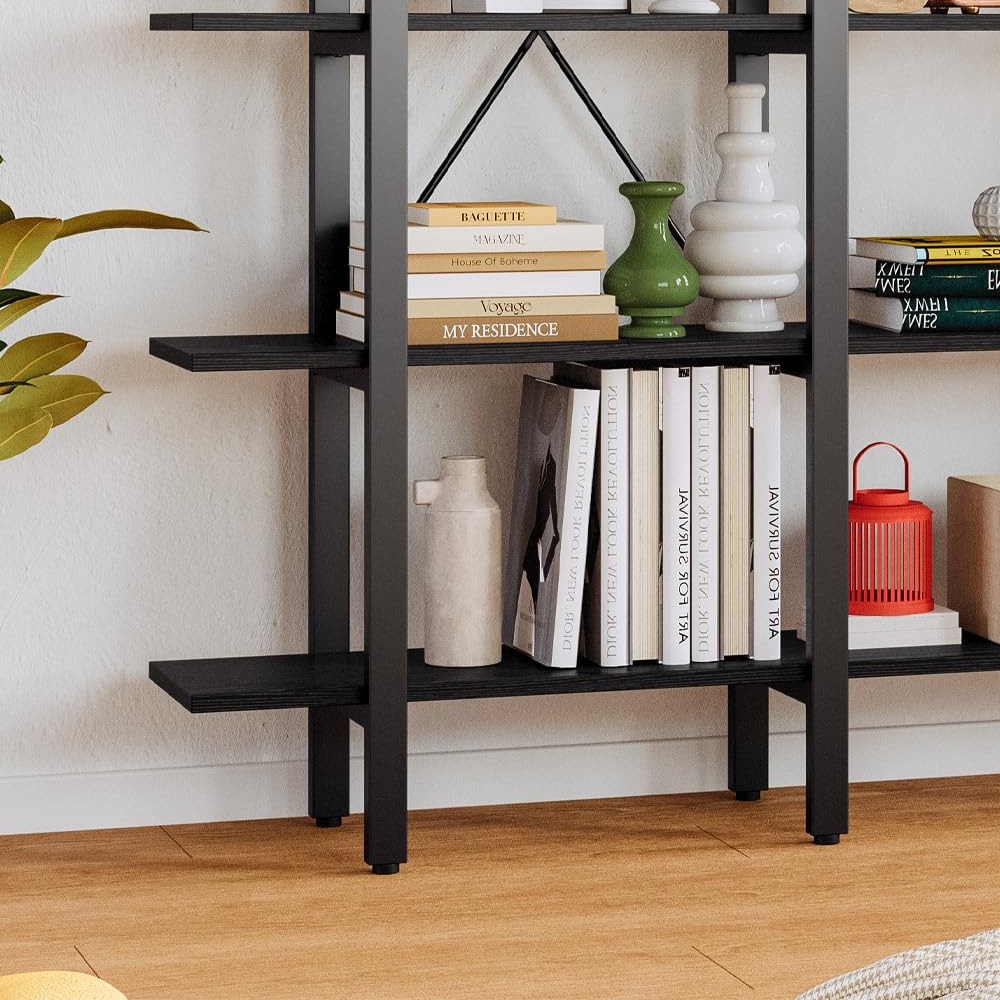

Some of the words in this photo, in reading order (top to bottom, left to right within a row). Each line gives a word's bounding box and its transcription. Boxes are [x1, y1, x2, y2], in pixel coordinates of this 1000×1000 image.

[461, 211, 526, 222] BAGUETTE
[473, 233, 527, 246] MAGAZINE
[451, 257, 482, 267] House
[484, 257, 497, 266] Of
[499, 256, 539, 266] Boheme
[480, 300, 533, 315] Voyage
[442, 325, 468, 339] MY
[472, 322, 559, 338] RESIDENCE
